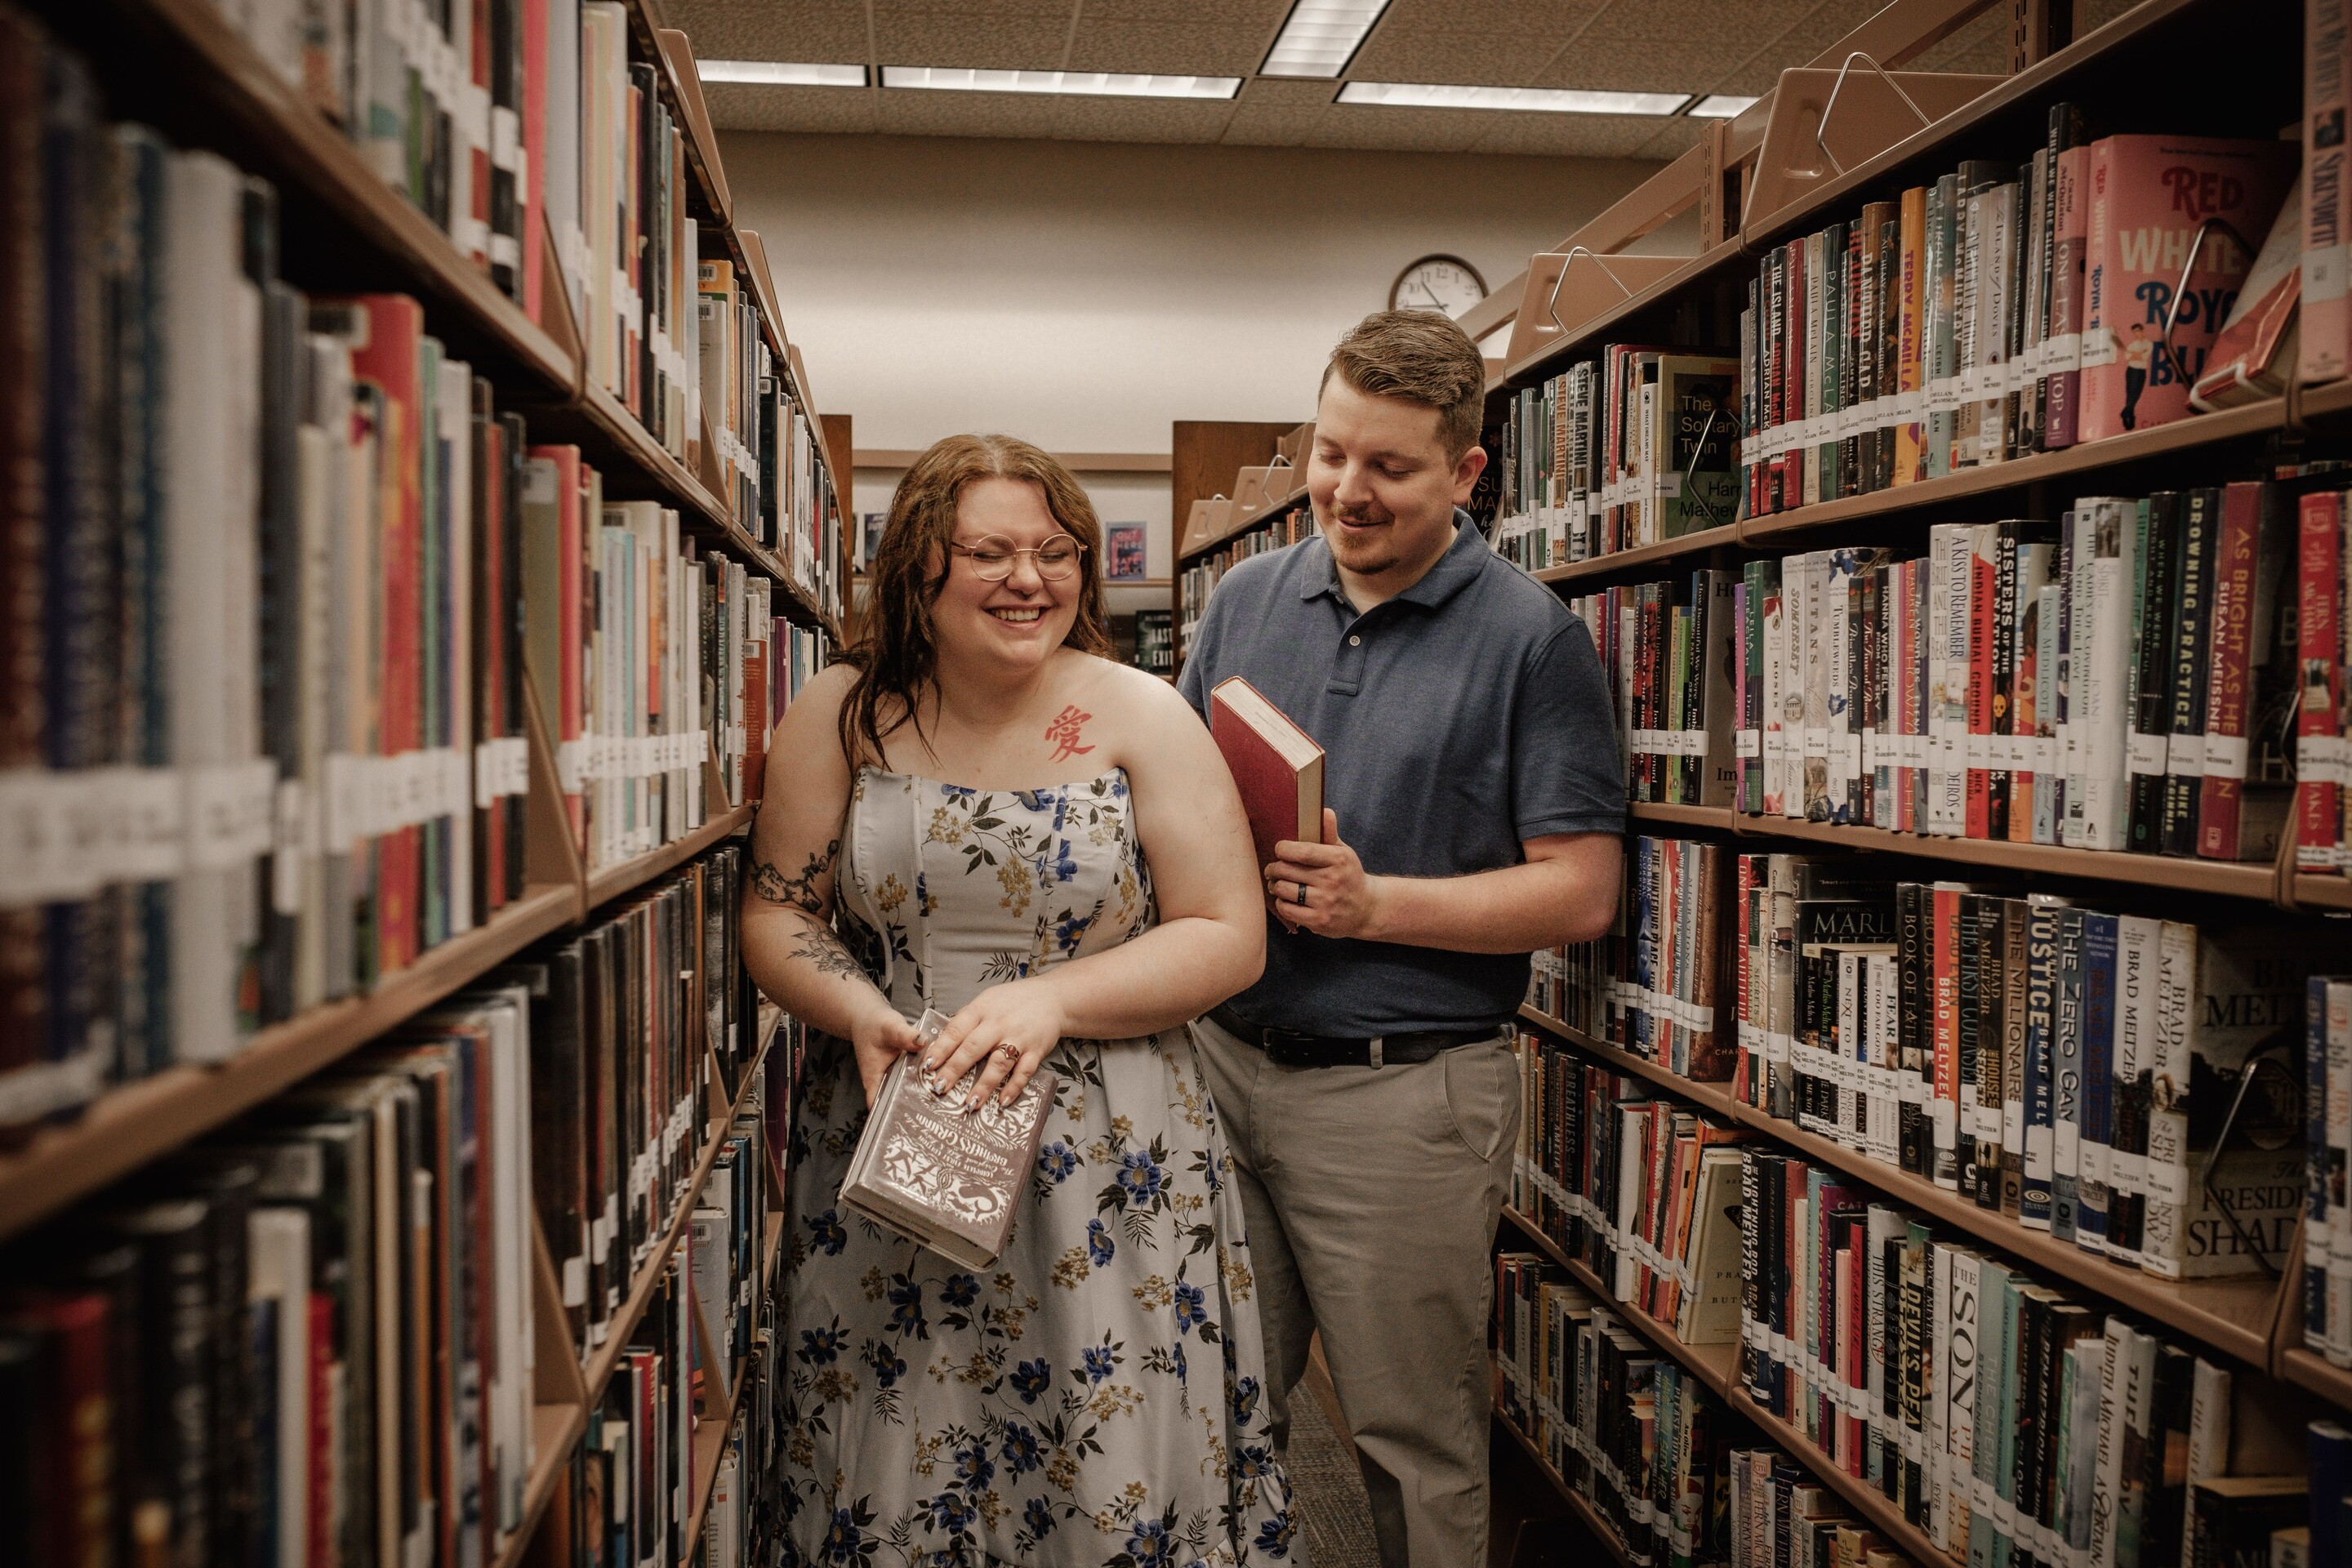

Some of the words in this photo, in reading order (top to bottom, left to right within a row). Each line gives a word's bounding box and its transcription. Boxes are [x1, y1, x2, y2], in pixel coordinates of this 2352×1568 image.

[2050, 126, 2058, 158] WHEN
[2048, 168, 2056, 188] WE
[2162, 166, 2245, 221] RED
[2046, 191, 2054, 227] WERE
[1993, 225, 2002, 274] ISLAND
[2044, 231, 2052, 273] SILENT
[2057, 244, 2069, 289] ONE
[1409, 283, 1420, 294] 10
[1437, 266, 1448, 279] 12
[1771, 264, 1782, 287] THE
[1904, 251, 1913, 310] TERRY
[1771, 292, 1781, 336] ISLAND
[1825, 271, 1836, 342] PAULA
[1992, 293, 2001, 337] DOVES
[1557, 381, 1566, 418] STEVE
[1576, 368, 1589, 407] STEVE
[1681, 395, 1712, 412] The
[1555, 423, 1565, 478] MARTINI
[1575, 412, 1588, 466] MARTINI
[1681, 438, 1717, 454] Twin
[1950, 549, 1967, 574] KISS
[1951, 537, 1965, 546] A
[2157, 539, 2167, 581] WHEN
[2183, 497, 2203, 609] DROWNING
[2234, 528, 2251, 559] AS
[1951, 577, 1964, 592] TO
[1972, 565, 1984, 614] INDIAN
[2001, 537, 2014, 626] SISTERS
[2155, 585, 2164, 604] WE
[1695, 608, 1703, 653] Beautiful
[1789, 588, 1801, 675] SOMERSET
[1810, 581, 1820, 665] TITANS
[1950, 595, 1967, 658] REMEMBER
[2042, 597, 2052, 634] JOAN
[2153, 611, 2162, 649] WERE
[2214, 581, 2230, 644] SUSAN
[2228, 570, 2248, 654] BRIGHT
[1832, 605, 1843, 688] TUMBLEWEEDS
[1848, 623, 1859, 674] Priscilla's
[1971, 619, 1982, 663] BURIAL
[2002, 631, 2010, 645] OF
[1695, 656, 1700, 671] We
[1864, 648, 1872, 672] Time
[2001, 649, 2010, 674] THE
[2039, 638, 2051, 715] MEDLICOTT
[2175, 620, 2195, 727] PRACTICE
[2225, 662, 2240, 693] AS
[1848, 676, 1858, 720] Promise
[1970, 671, 1981, 726] GROUND
[1045, 705, 1096, 764] 愛
[1974, 773, 1983, 795] NICK
[2177, 786, 2189, 818] MIKE
[1651, 849, 1660, 868] THE
[1650, 871, 1659, 929] WINTERING
[1739, 865, 1747, 904] ONLY
[1906, 891, 1915, 908] THE
[1650, 933, 1658, 966] PLACE
[1904, 914, 1917, 969] BOOK
[2011, 915, 2025, 960] THE
[2063, 915, 2082, 971] THE
[1768, 929, 1778, 991] Cleopatra
[1980, 938, 1992, 1015] MELTZER
[1992, 959, 2001, 999] BRAD
[2028, 905, 2050, 1029] JUSTICE
[2127, 950, 2140, 999] BRAD
[1806, 975, 1815, 996] Marliss
[1822, 978, 1831, 1008] Marliss
[1841, 987, 1852, 1021] NEXT
[1904, 971, 1916, 995] OF
[1938, 978, 1949, 1019] BRAD
[1806, 998, 1815, 1024] Melton
[1821, 1009, 1831, 1032] Melton
[1886, 995, 1896, 1038] FEAR
[2060, 982, 2079, 1058] ZERO
[2155, 956, 2172, 1069] MELTZER
[2170, 986, 2187, 1046] BRAD
[1844, 1027, 1851, 1044] TO
[2038, 1028, 2048, 1073] BRAD
[2123, 1005, 2138, 1083] MELTZER
[1806, 1084, 1813, 1096] ME
[1987, 1058, 1999, 1099] HOUSE
[1566, 1072, 1576, 1156] BREATHLESS
[1820, 1089, 1829, 1119] DARK
[1856, 1091, 1866, 1133] MELTON
[944, 1154, 960, 1167] FIRST
[960, 1137, 1008, 1166] BROTHERS
[1742, 1152, 1752, 1204] BRAD
[1751, 1176, 1759, 1248] LIGHTNING
[1742, 1206, 1752, 1281] MELTZER
[1873, 1255, 1885, 1290] THIS
[1926, 1253, 1934, 1293] JOYCE
[1953, 1263, 1978, 1286] THE
[1872, 1293, 1884, 1357] STRANGE
[1905, 1289, 1920, 1372] DEVIL'S
[1952, 1285, 1976, 1419] SON
[2103, 1333, 2119, 1391] JUDITH
[1976, 1352, 1984, 1440] STEPHENIE
[1986, 1356, 1998, 1399] THE
[1684, 1423, 1689, 1434] An
[2097, 1395, 2115, 1467] MICHAEL
[1776, 1477, 1793, 1512] FERN
[2015, 1459, 2025, 1505] LOVE
[1754, 1500, 1763, 1530] FERN
